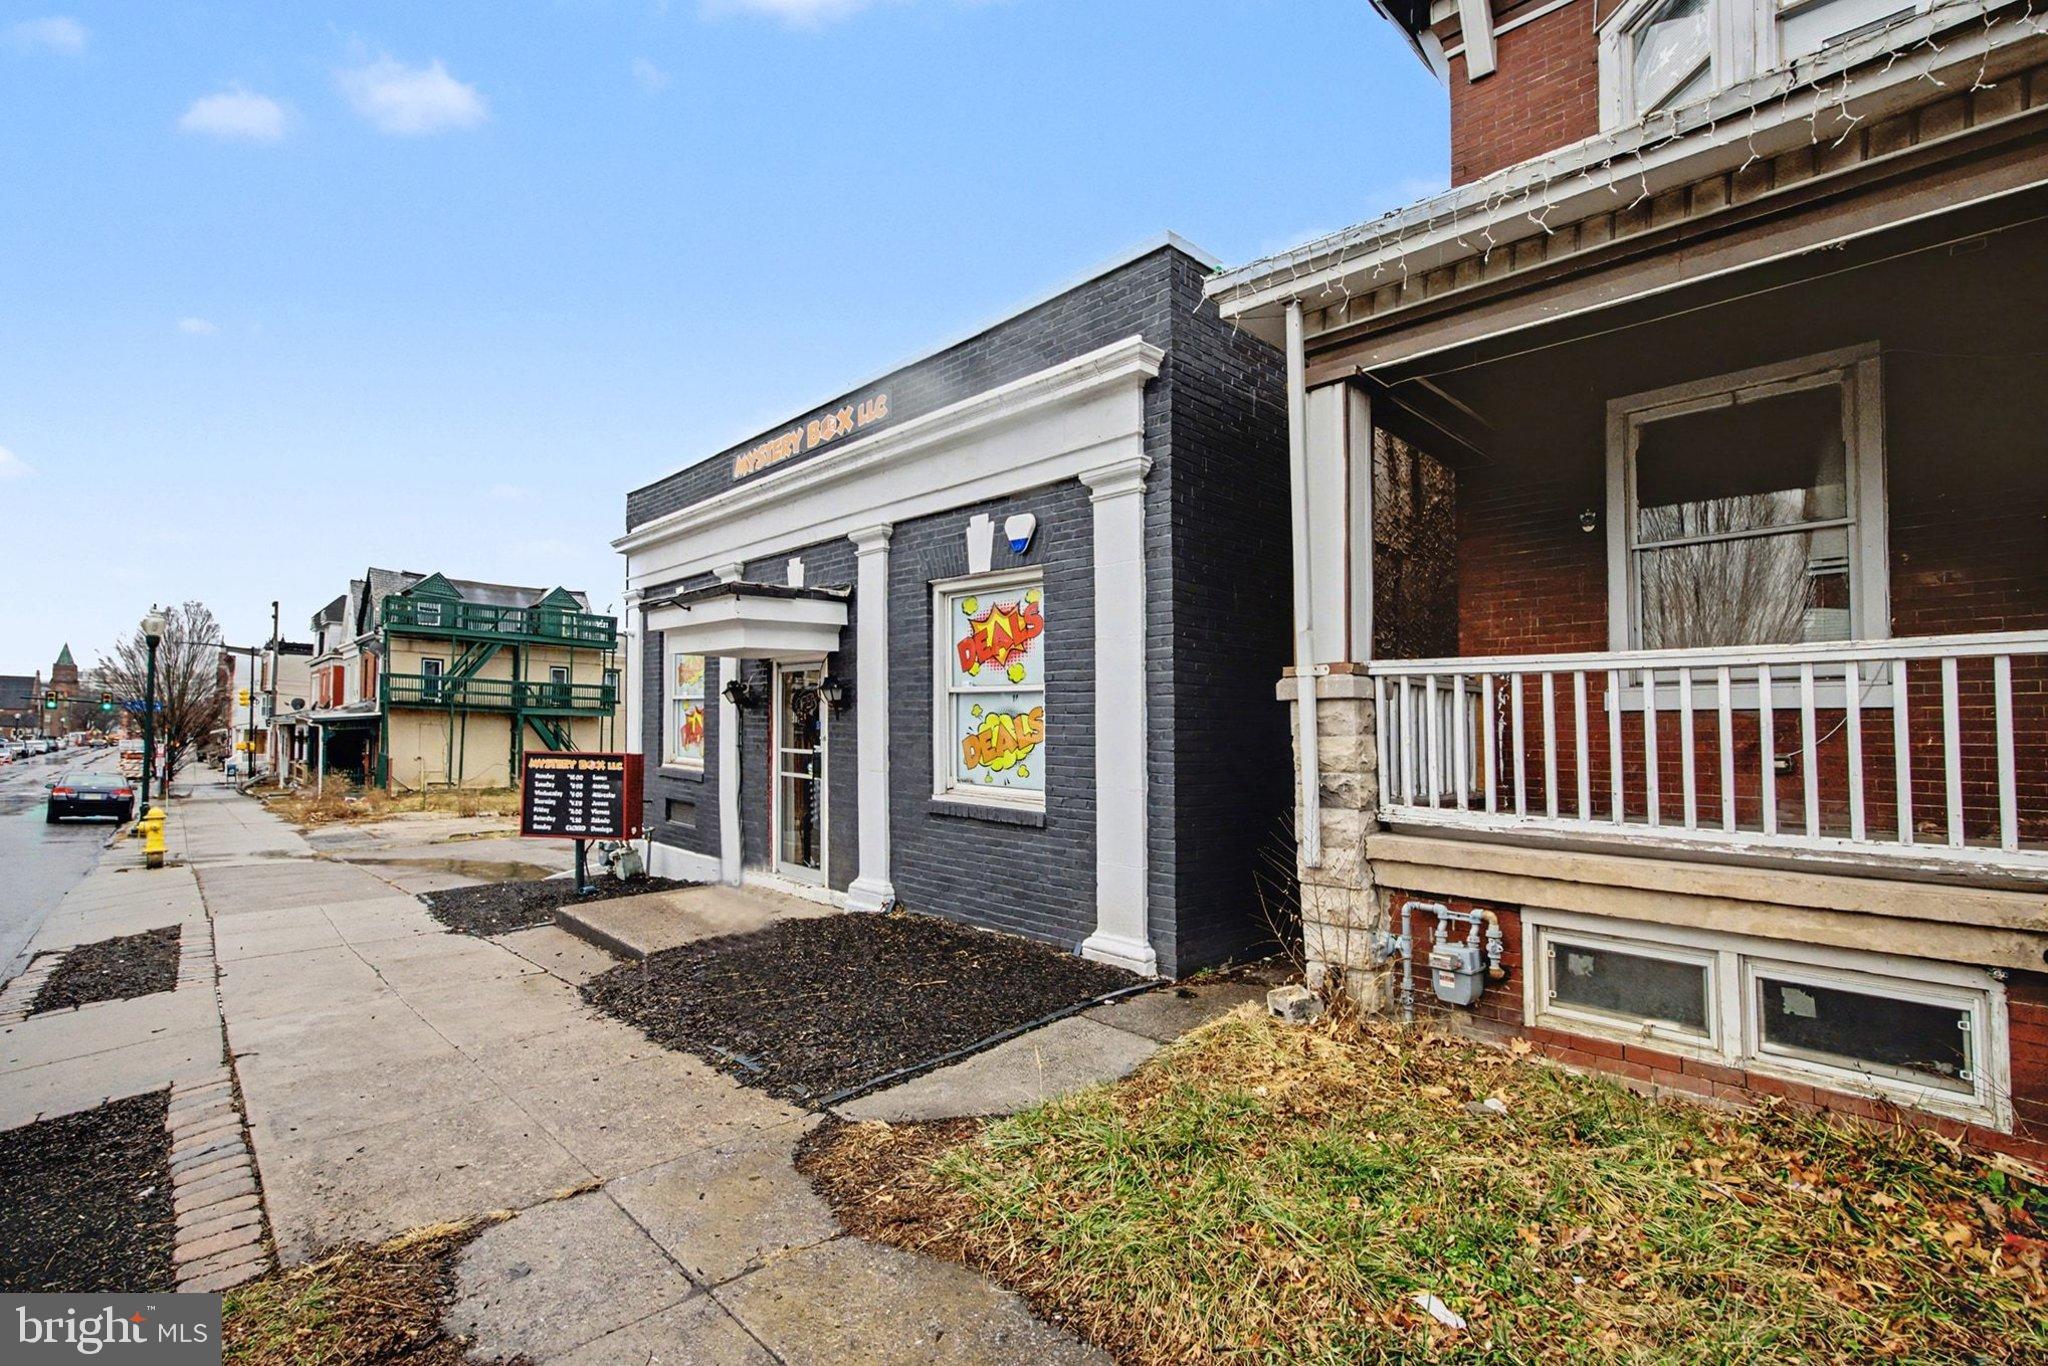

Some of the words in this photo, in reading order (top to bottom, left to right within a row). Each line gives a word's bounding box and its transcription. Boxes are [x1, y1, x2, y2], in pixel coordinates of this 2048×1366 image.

[733, 428, 804, 479] MYSTERY
[807, 405, 854, 449] BOX
[857, 393, 889, 427] LLC
[957, 602, 1044, 673] DEALS
[528, 758, 577, 770] MYSTERY
[607, 761, 623, 770] LLC
[962, 706, 1044, 770] DEALS
